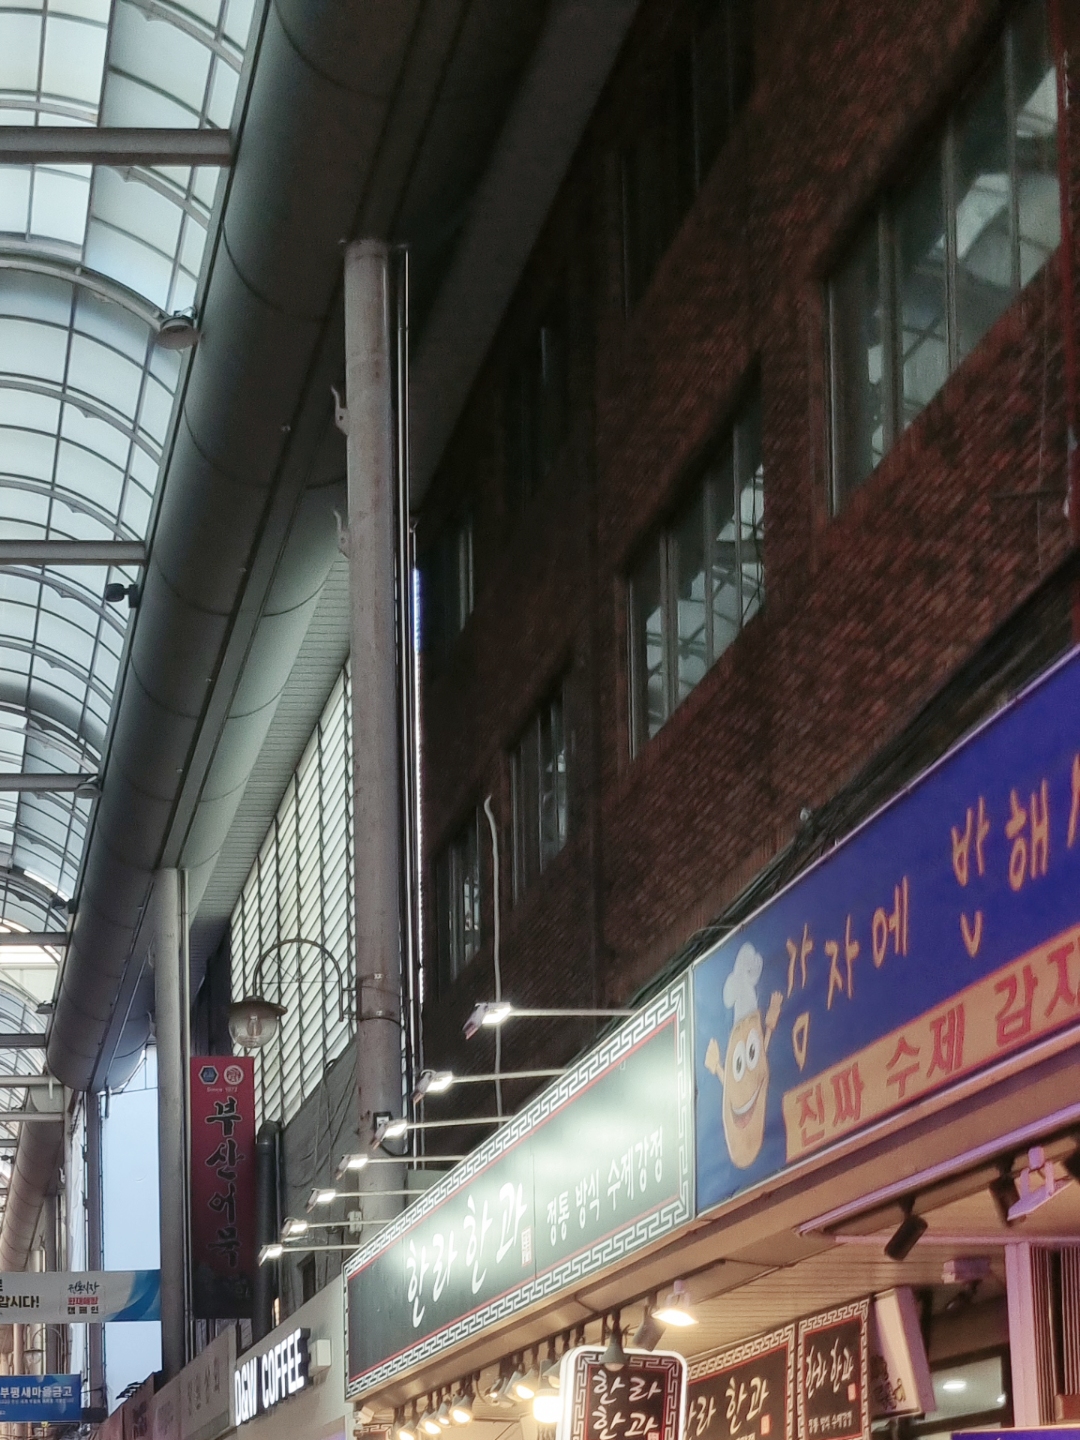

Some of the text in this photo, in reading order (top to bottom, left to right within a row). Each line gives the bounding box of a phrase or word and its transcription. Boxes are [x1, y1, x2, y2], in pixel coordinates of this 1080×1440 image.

[786, 753, 1080, 1072] 감자에 반해
[886, 1003, 966, 1099] 수제
[204, 1096, 246, 1268] 부산어묵
[575, 1168, 601, 1230] 방식
[607, 1124, 664, 1212] 수제강정
[261, 1328, 305, 1409] COFFEE
[592, 1369, 662, 1405] 한라
[725, 1376, 770, 1435] 한과
[592, 1407, 659, 1440] 한과
